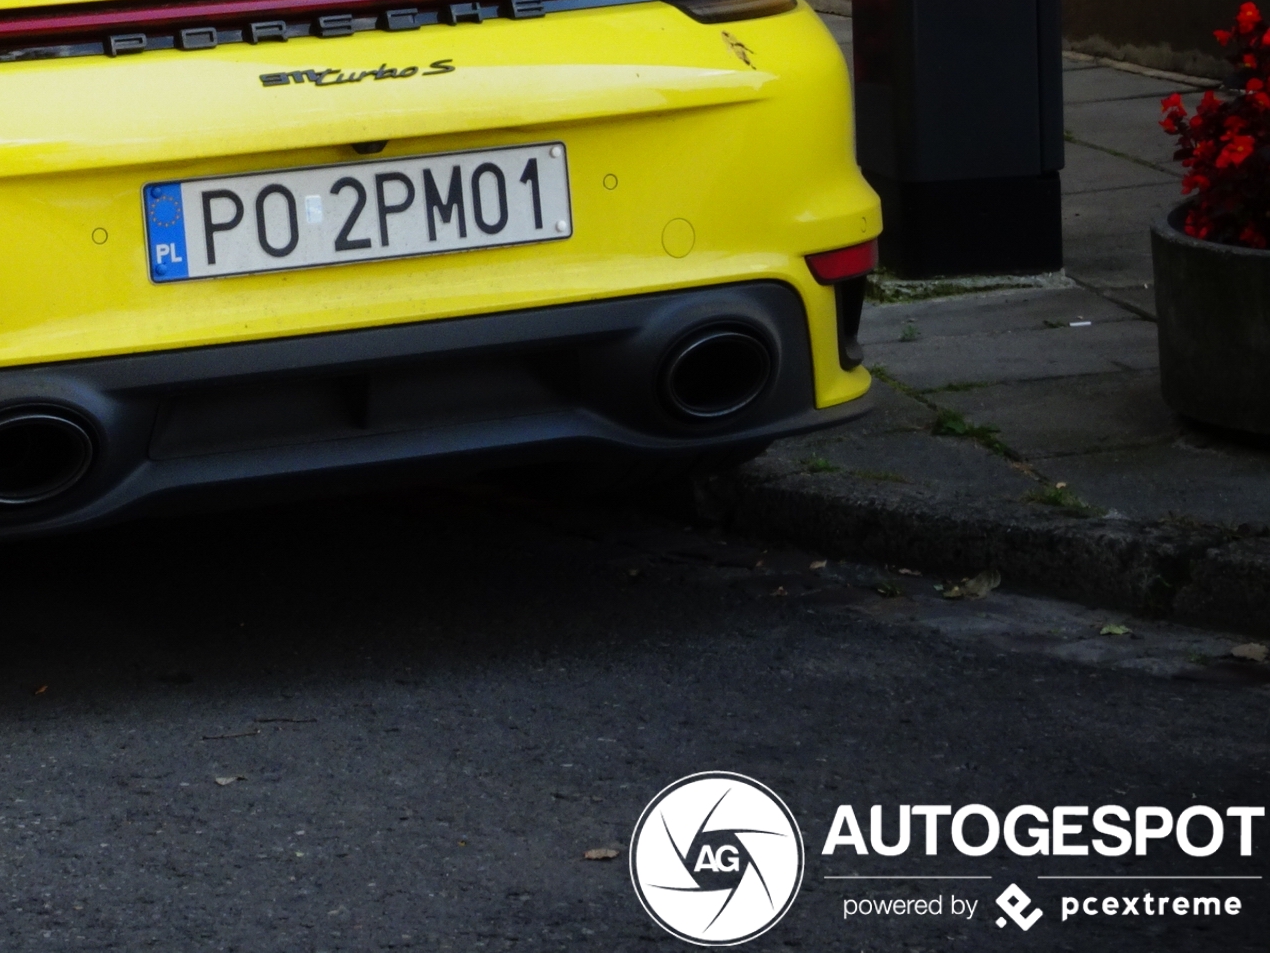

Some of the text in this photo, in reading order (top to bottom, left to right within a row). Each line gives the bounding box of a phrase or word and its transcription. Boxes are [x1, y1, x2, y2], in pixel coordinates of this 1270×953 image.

[201, 157, 544, 266] PO 2PM01
[156, 243, 183, 264] PL
